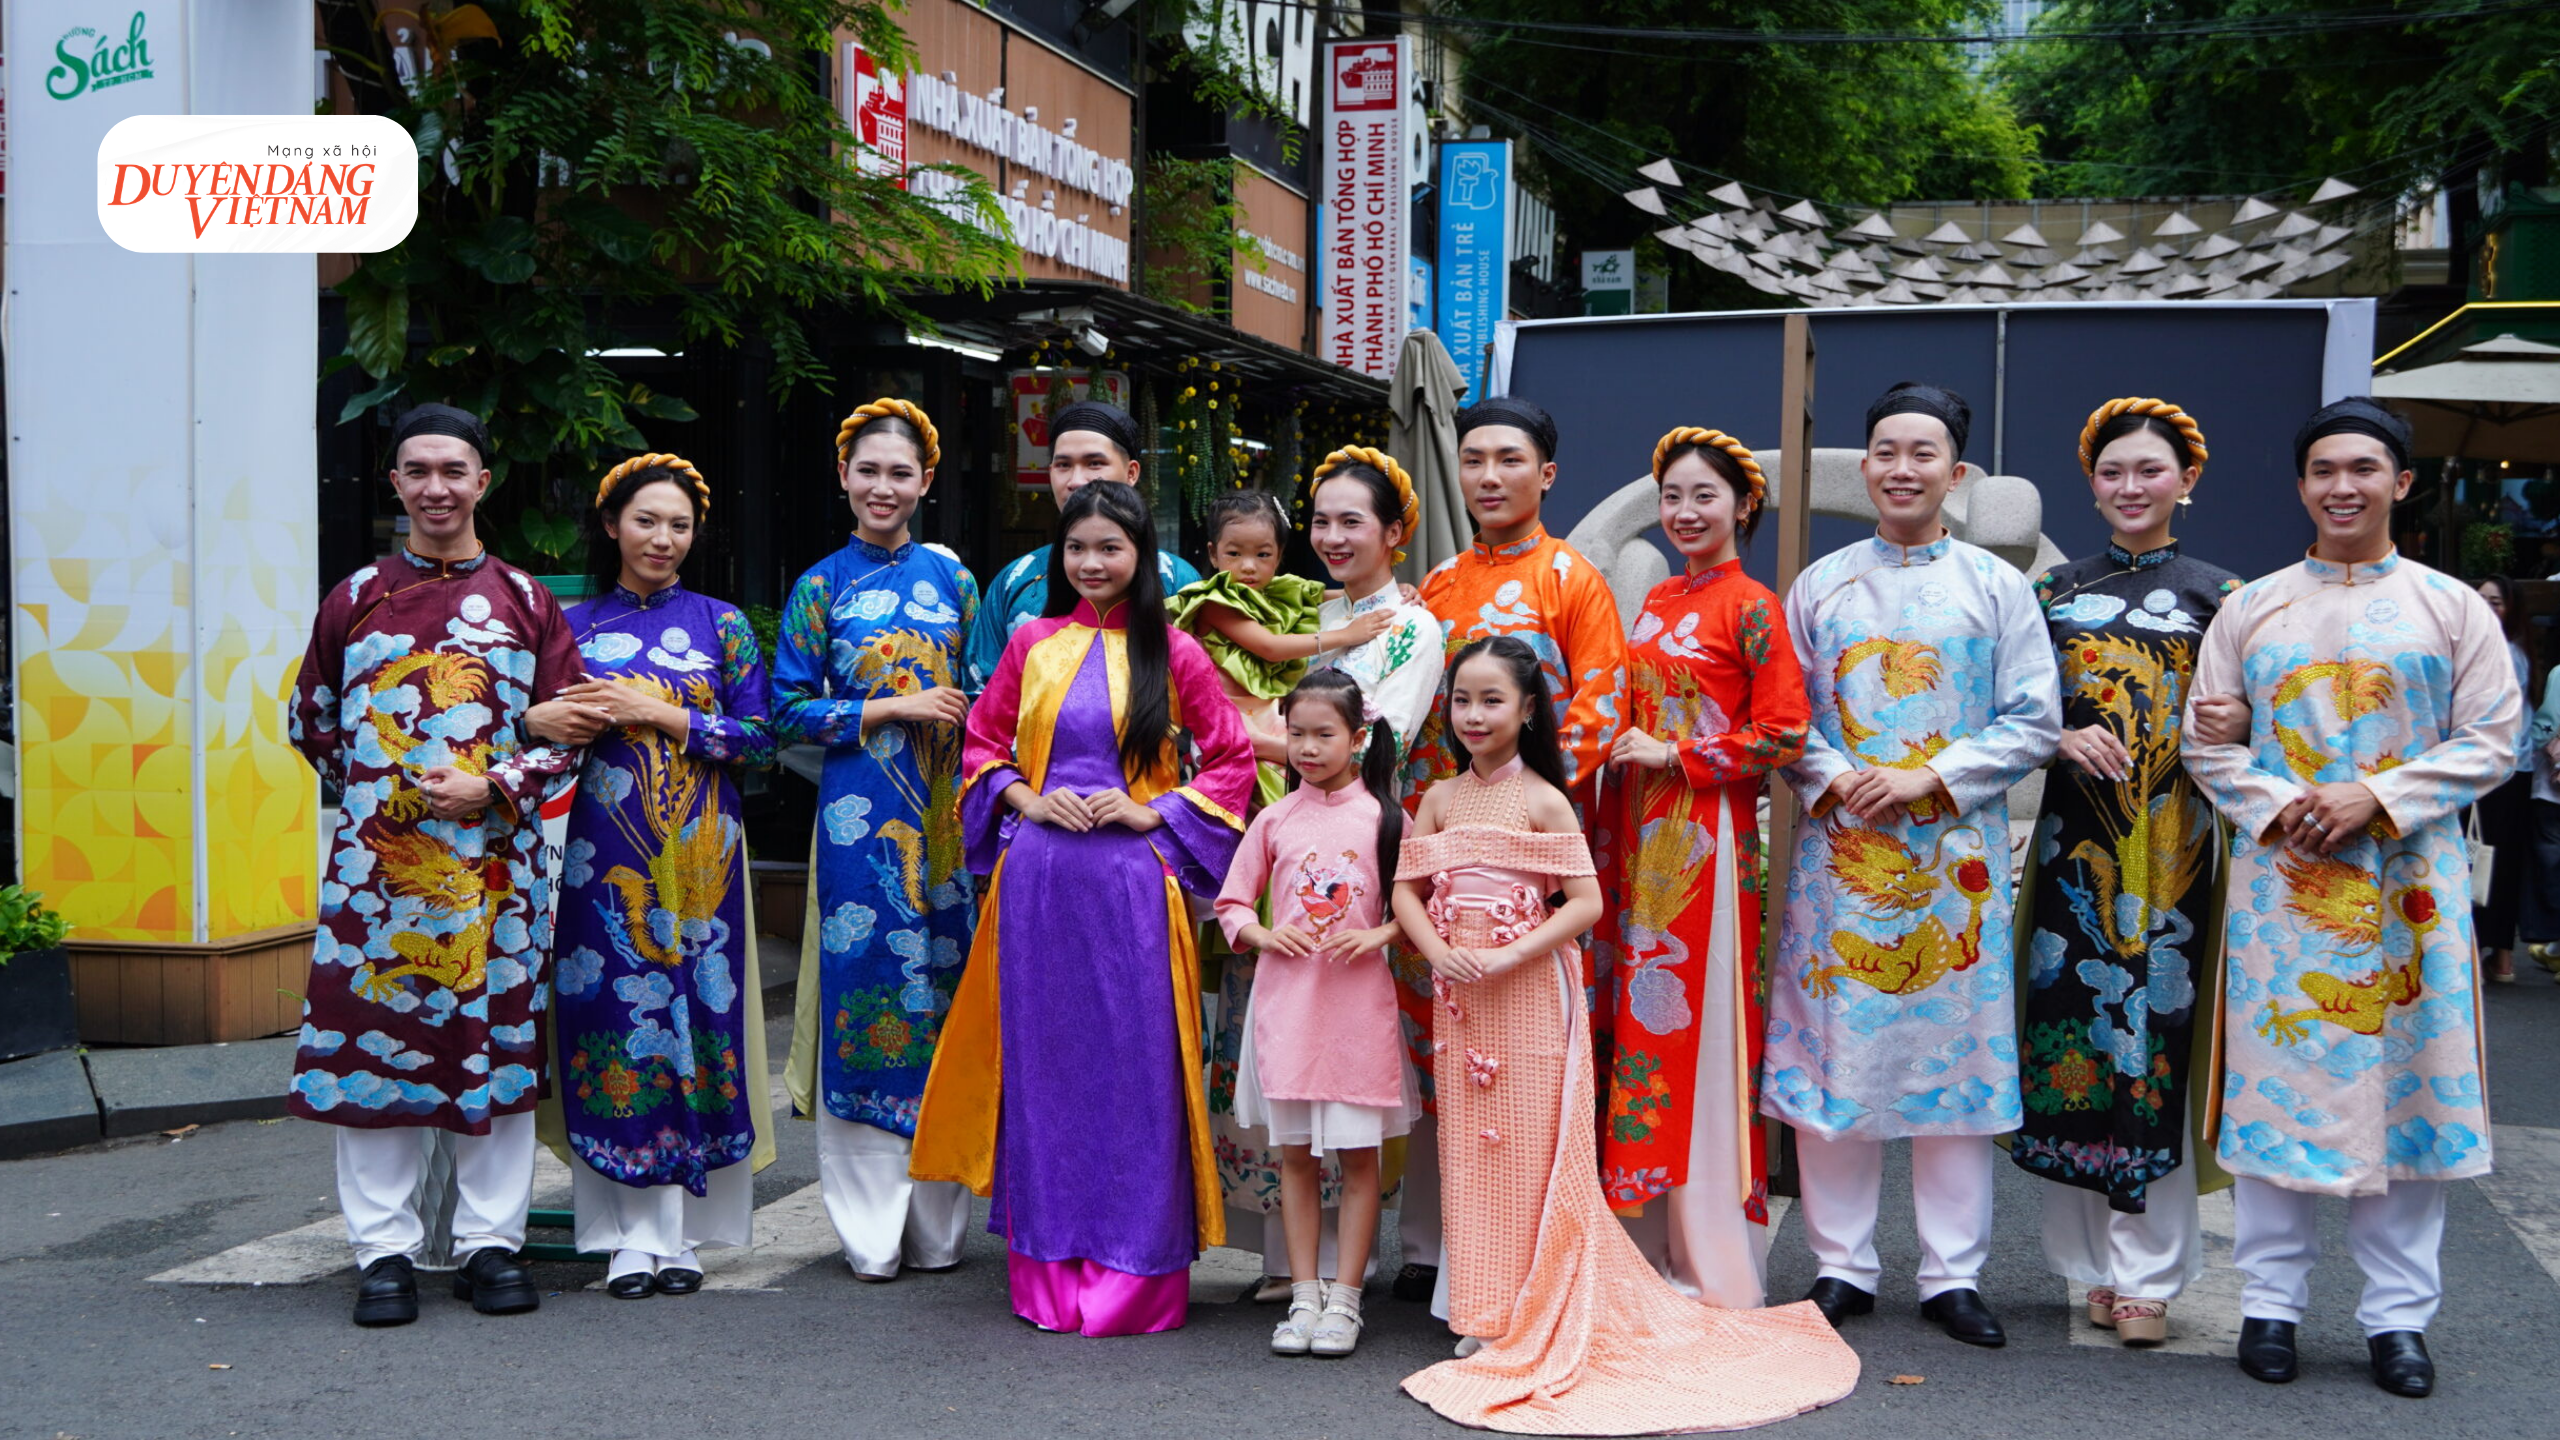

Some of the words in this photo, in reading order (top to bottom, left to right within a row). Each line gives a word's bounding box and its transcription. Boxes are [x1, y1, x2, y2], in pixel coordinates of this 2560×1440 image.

[46, 10, 155, 101] Sách
[907, 70, 959, 136] NHÀ
[958, 87, 1014, 157] XUẤT
[1011, 106, 1053, 176] BẢN
[1052, 118, 1099, 195] TỔNG
[1098, 157, 1134, 216] HỢP
[1335, 120, 1361, 162] HỢP
[1366, 123, 1385, 176] MINH
[1331, 168, 1355, 224] TỔNG
[1363, 182, 1385, 215] CHÍ
[1027, 190, 1058, 258] HỒ
[1056, 214, 1088, 268] CHÍ
[1087, 230, 1129, 283] MINH
[1331, 229, 1355, 269] BẢN
[1361, 220, 1385, 250] HỒ
[1451, 222, 1474, 257] TRẺ
[1361, 256, 1384, 297] PHỐ
[1450, 264, 1473, 301] BẢN
[1478, 249, 1490, 286] HOUSE
[1331, 275, 1355, 325] XUẤT
[1361, 304, 1384, 373] THÀNH
[1448, 309, 1472, 356] XUẤT
